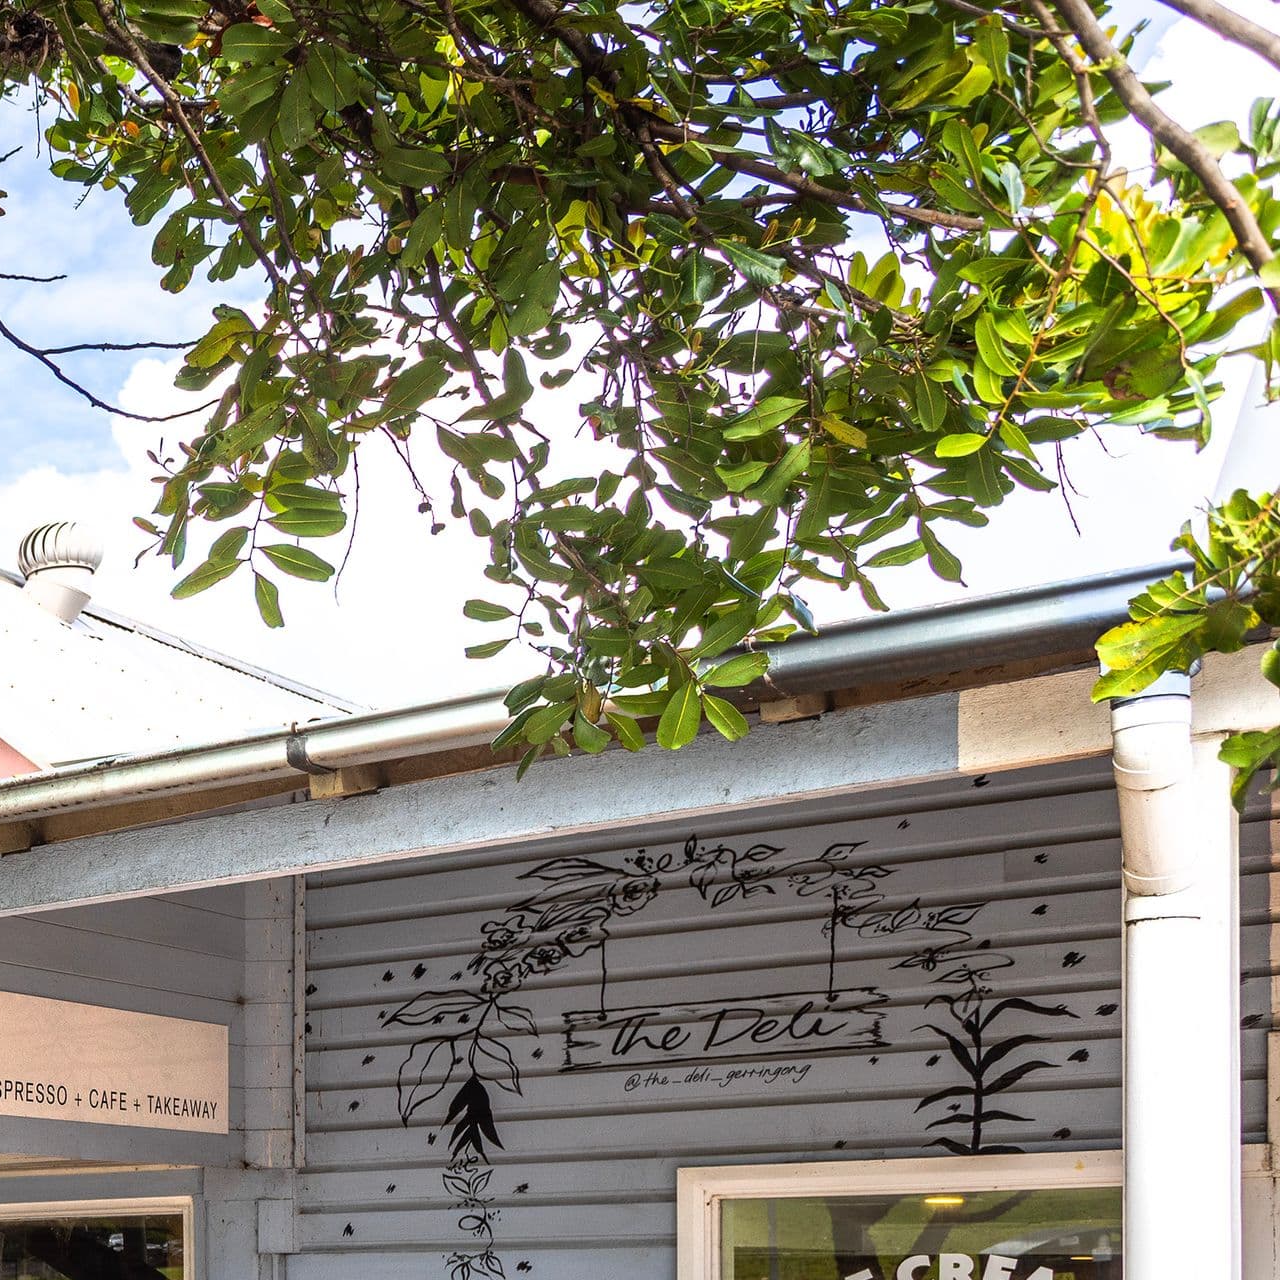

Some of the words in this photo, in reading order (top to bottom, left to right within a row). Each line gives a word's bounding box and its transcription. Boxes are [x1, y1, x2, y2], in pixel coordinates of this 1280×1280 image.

[599, 1012, 691, 1056] The
[699, 1001, 848, 1051] Deli
[89, 1088, 128, 1112] CAFE
[147, 1095, 218, 1120] TAKEAWAY
